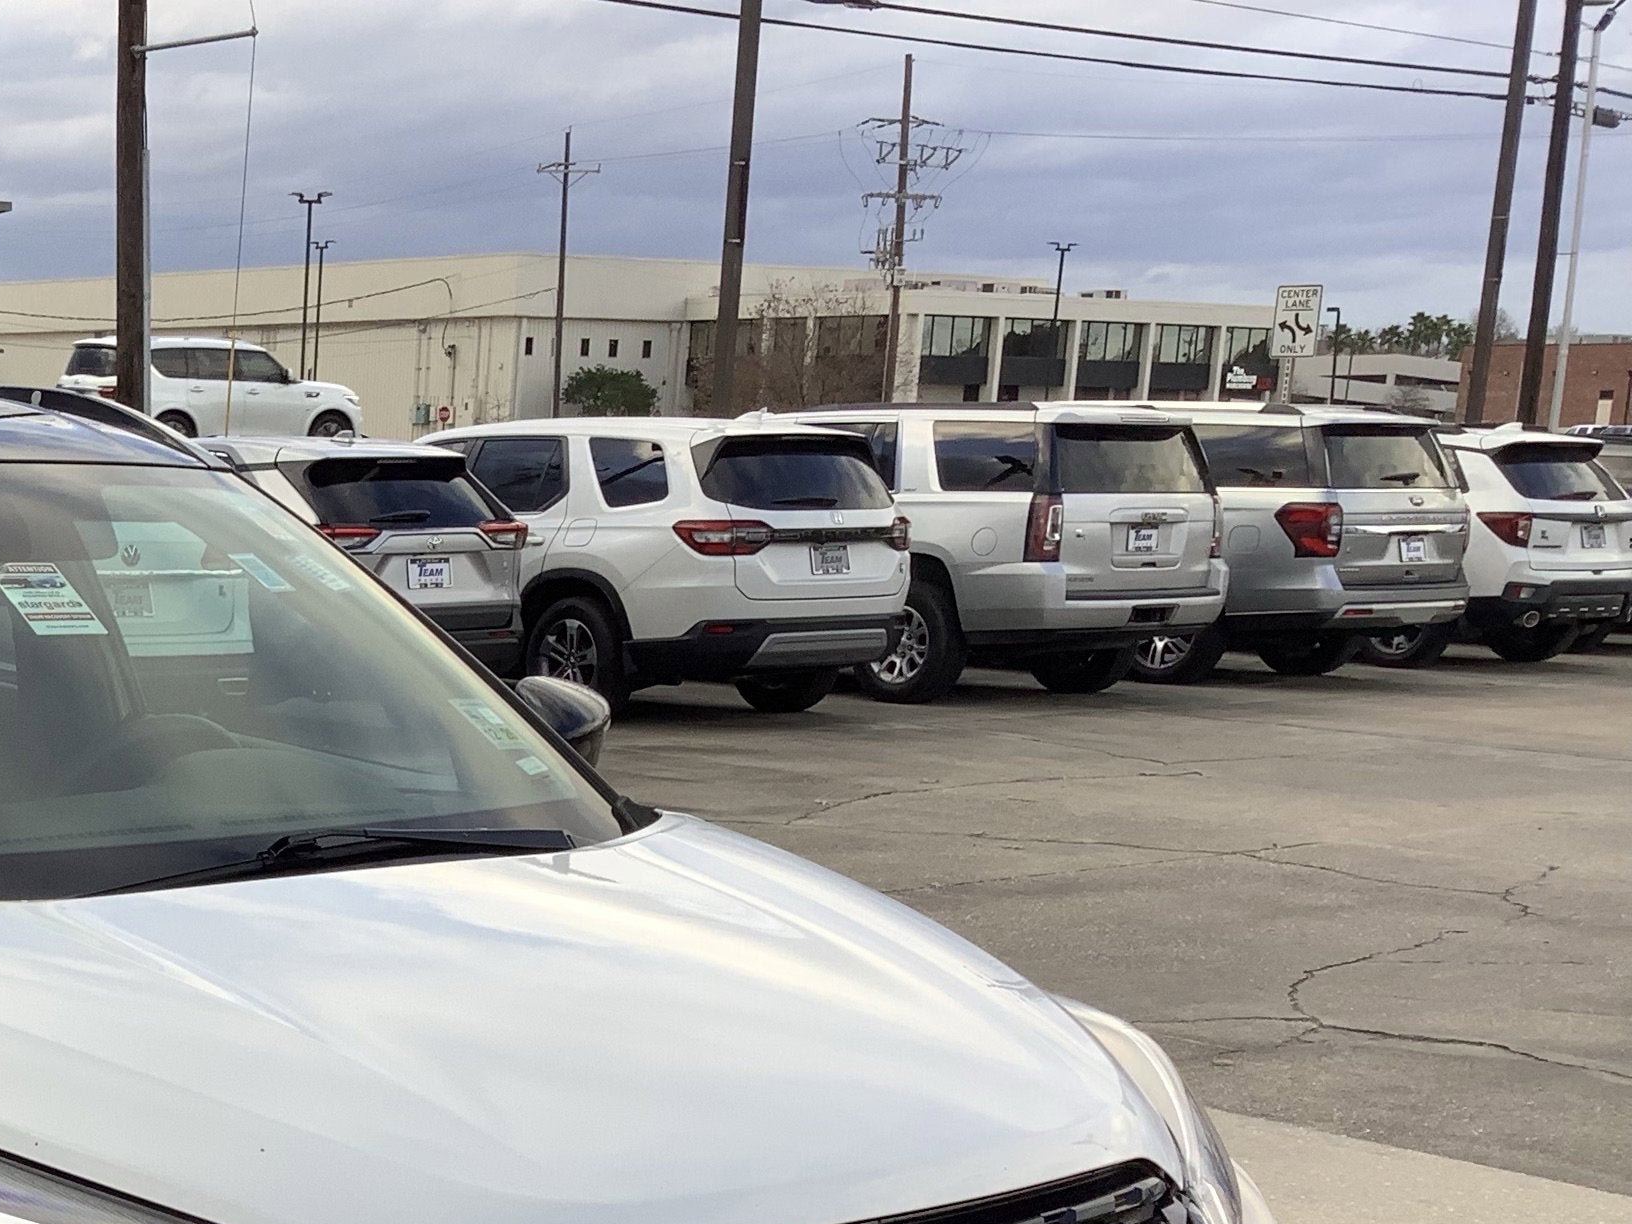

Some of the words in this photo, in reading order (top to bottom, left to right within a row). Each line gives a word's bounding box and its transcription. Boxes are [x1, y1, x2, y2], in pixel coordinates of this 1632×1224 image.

[1280, 288, 1319, 299] CENTER
[1285, 299, 1312, 309] LANE
[1279, 344, 1306, 353] ONLY
[818, 550, 843, 564] TEAM
[7, 565, 55, 573] ATTENTION
[417, 561, 444, 577] TEAM
